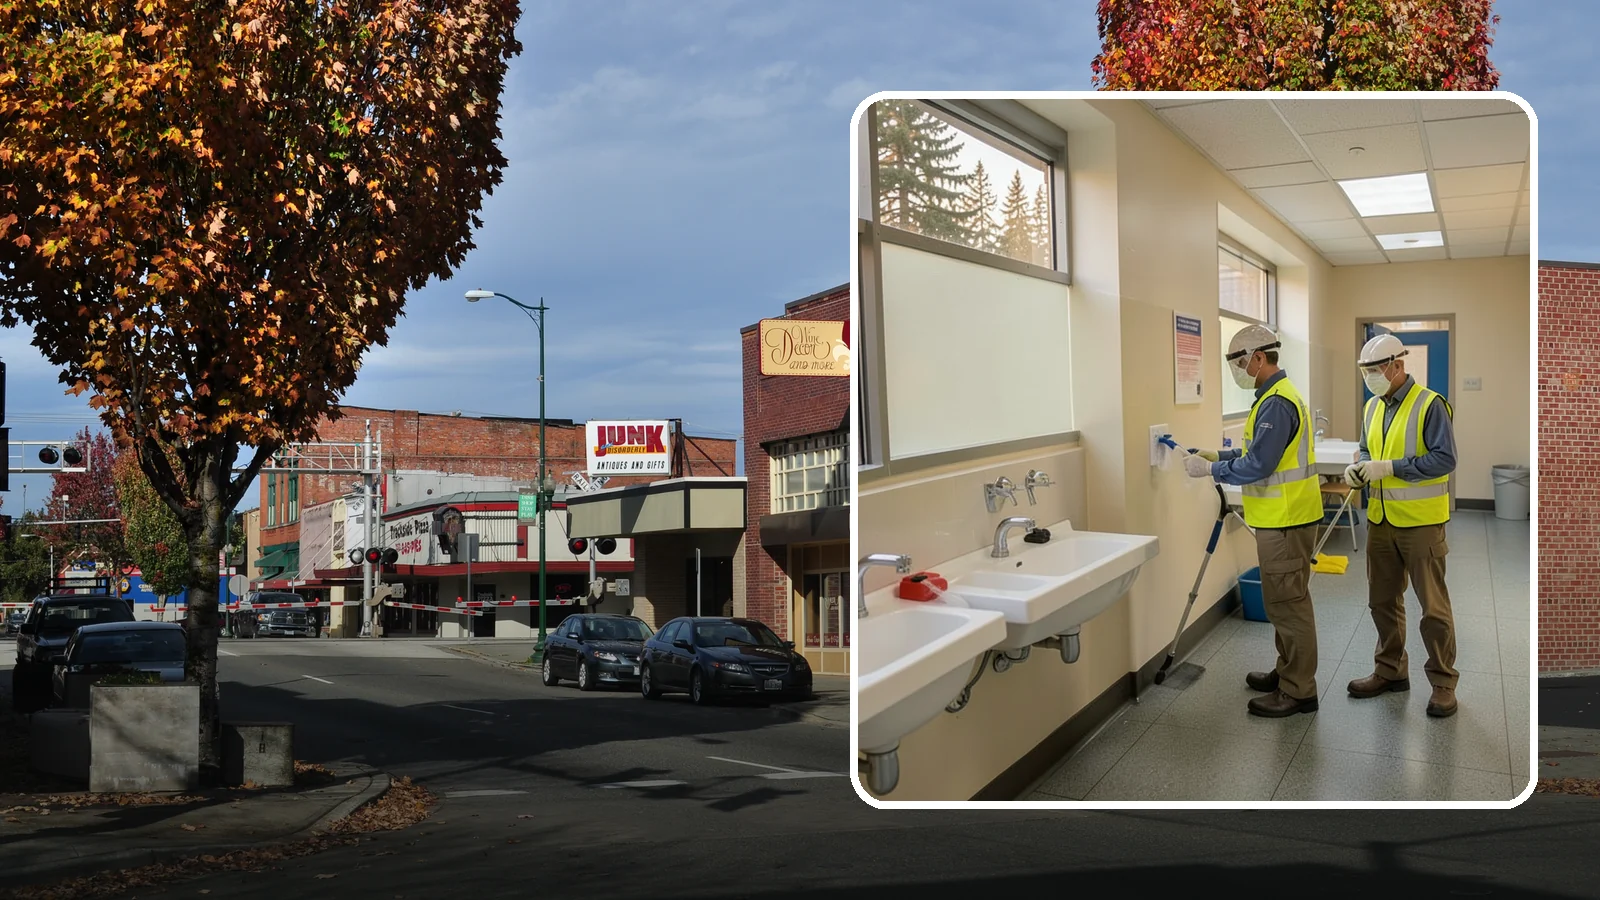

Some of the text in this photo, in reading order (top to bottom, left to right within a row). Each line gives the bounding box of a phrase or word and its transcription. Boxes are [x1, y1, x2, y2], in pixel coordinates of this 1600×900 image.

[595, 425, 665, 457] JUNK
[607, 446, 646, 454] DISORDERLY
[597, 460, 665, 470] ANTIQUES AND GIFTS
[414, 520, 429, 535] Pizza
